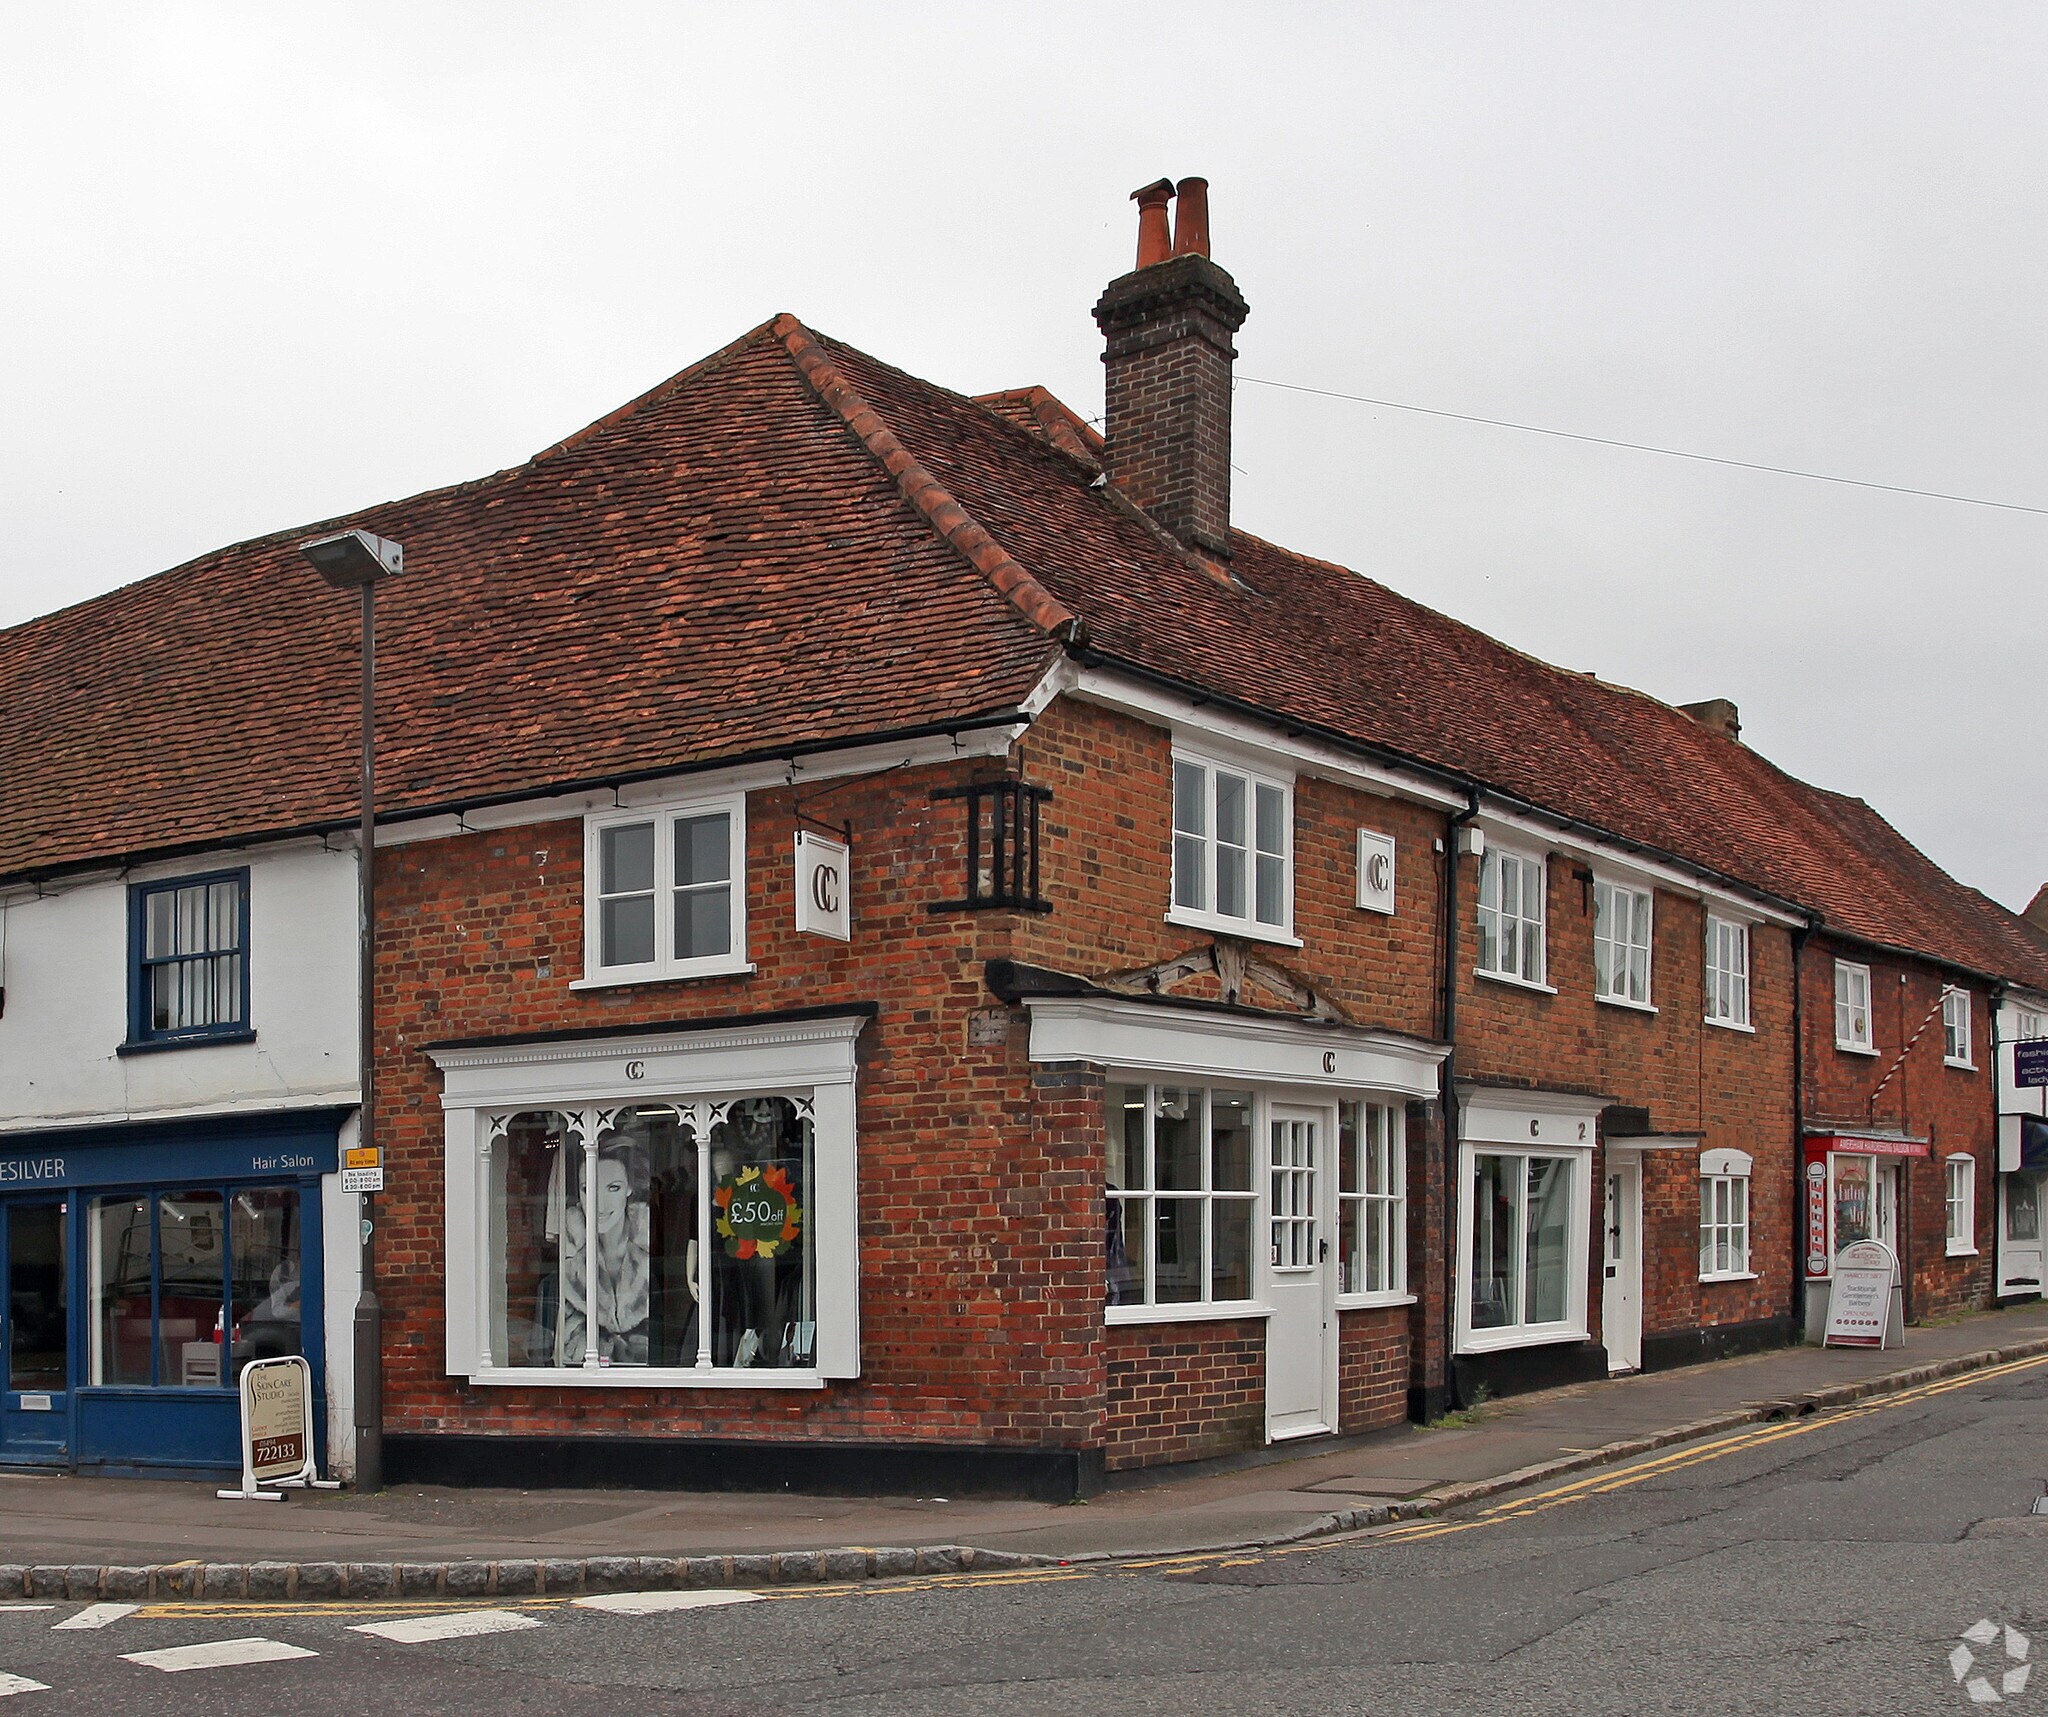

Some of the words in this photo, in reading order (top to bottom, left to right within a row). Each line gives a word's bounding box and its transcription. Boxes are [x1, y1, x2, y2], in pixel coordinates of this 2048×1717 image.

[2017, 1049, 2048, 1058] fashi
[252, 1156, 277, 1169] Hair
[281, 1154, 314, 1168] Salon
[257, 1390, 285, 1401] STUDIO
[257, 1443, 295, 1462] 722133
